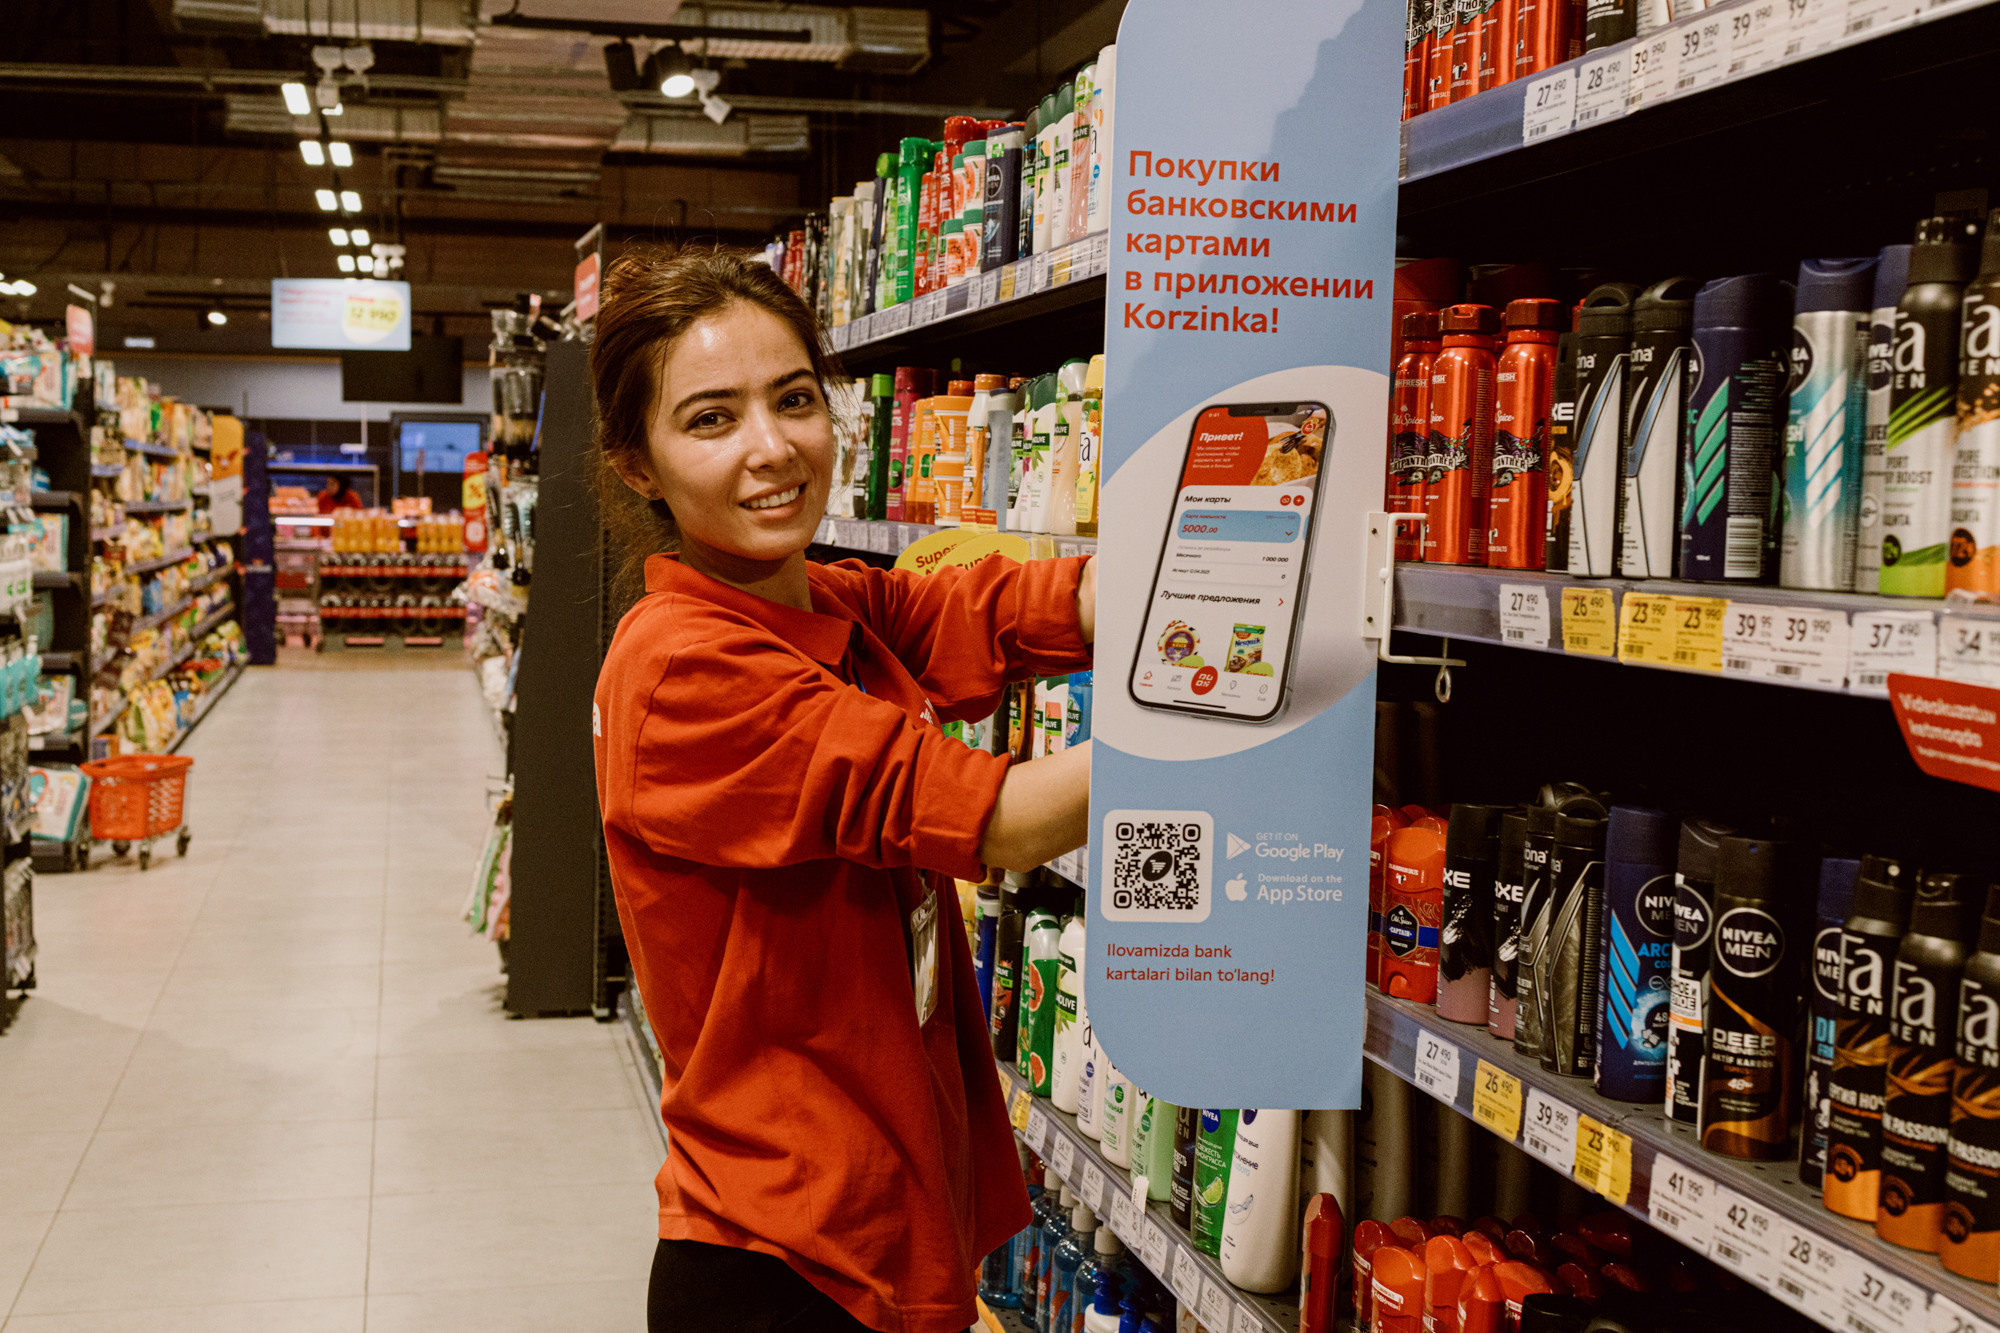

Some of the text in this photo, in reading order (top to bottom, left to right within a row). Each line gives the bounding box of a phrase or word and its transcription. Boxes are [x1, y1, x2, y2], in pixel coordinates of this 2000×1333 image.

[1733, 14, 1750, 41] 39
[1682, 24, 1719, 57] 39 990
[1632, 41, 1666, 74] 39 990
[1587, 61, 1621, 90] 28 490
[1536, 78, 1567, 107] 27 490
[1129, 150, 1280, 187] Покупки
[1127, 188, 1357, 223] банковскими
[1126, 232, 1270, 261] картами
[1125, 271, 1374, 300] в приложении
[1124, 302, 1279, 334] Korzinka!
[1895, 373, 1926, 389] EN
[1403, 412, 1424, 426] Spice
[1199, 431, 1244, 443] Привет!
[1204, 496, 1232, 504] карты
[1182, 524, 1218, 533] 5000.00
[1160, 590, 1261, 605] Лучшие предложения
[1511, 592, 1539, 611] 27 490
[1573, 596, 1604, 616] 26 490
[1632, 602, 1667, 623] 23 990
[1684, 606, 1722, 629] 23 990
[1736, 613, 1756, 637] 39
[1785, 617, 1831, 642] 39 990
[1869, 622, 1920, 648] 37 490
[1235, 638, 1260, 647] Nesquik
[1955, 628, 1981, 655] 34
[1256, 832, 1298, 841] GET IT ON
[1255, 842, 1345, 862] Google Play
[1258, 873, 1308, 883] Download
[1326, 874, 1343, 883] the
[1256, 884, 1343, 904] App Store
[1645, 895, 1675, 909] NIV
[1651, 910, 1673, 921] ME
[1722, 927, 1778, 945] NIVEA
[1107, 944, 1232, 958] Ilovamizda bank
[1638, 943, 1673, 957] ARC
[1725, 942, 1771, 959] MEN
[1106, 967, 1170, 981] kartalari
[1175, 968, 1212, 982] bilan
[1655, 960, 1672, 969] COO
[1818, 963, 1840, 980] ME
[1838, 933, 1883, 999] Fa
[1891, 959, 1936, 1030] Fa
[1956, 978, 2000, 1050] Fa
[1713, 1027, 1776, 1049] DEEP
[1426, 1041, 1451, 1061] 27 490
[1485, 1072, 1513, 1094] 26 490
[1202, 1110, 1219, 1123] NIVEA
[1536, 1101, 1568, 1126] 39 990
[1588, 1129, 1620, 1152] 23 990
[1668, 1172, 1704, 1197] 41 990
[1727, 1204, 1769, 1232] 42 490
[1789, 1236, 1836, 1268] 28 990
[1861, 1273, 1886, 1301] 37
